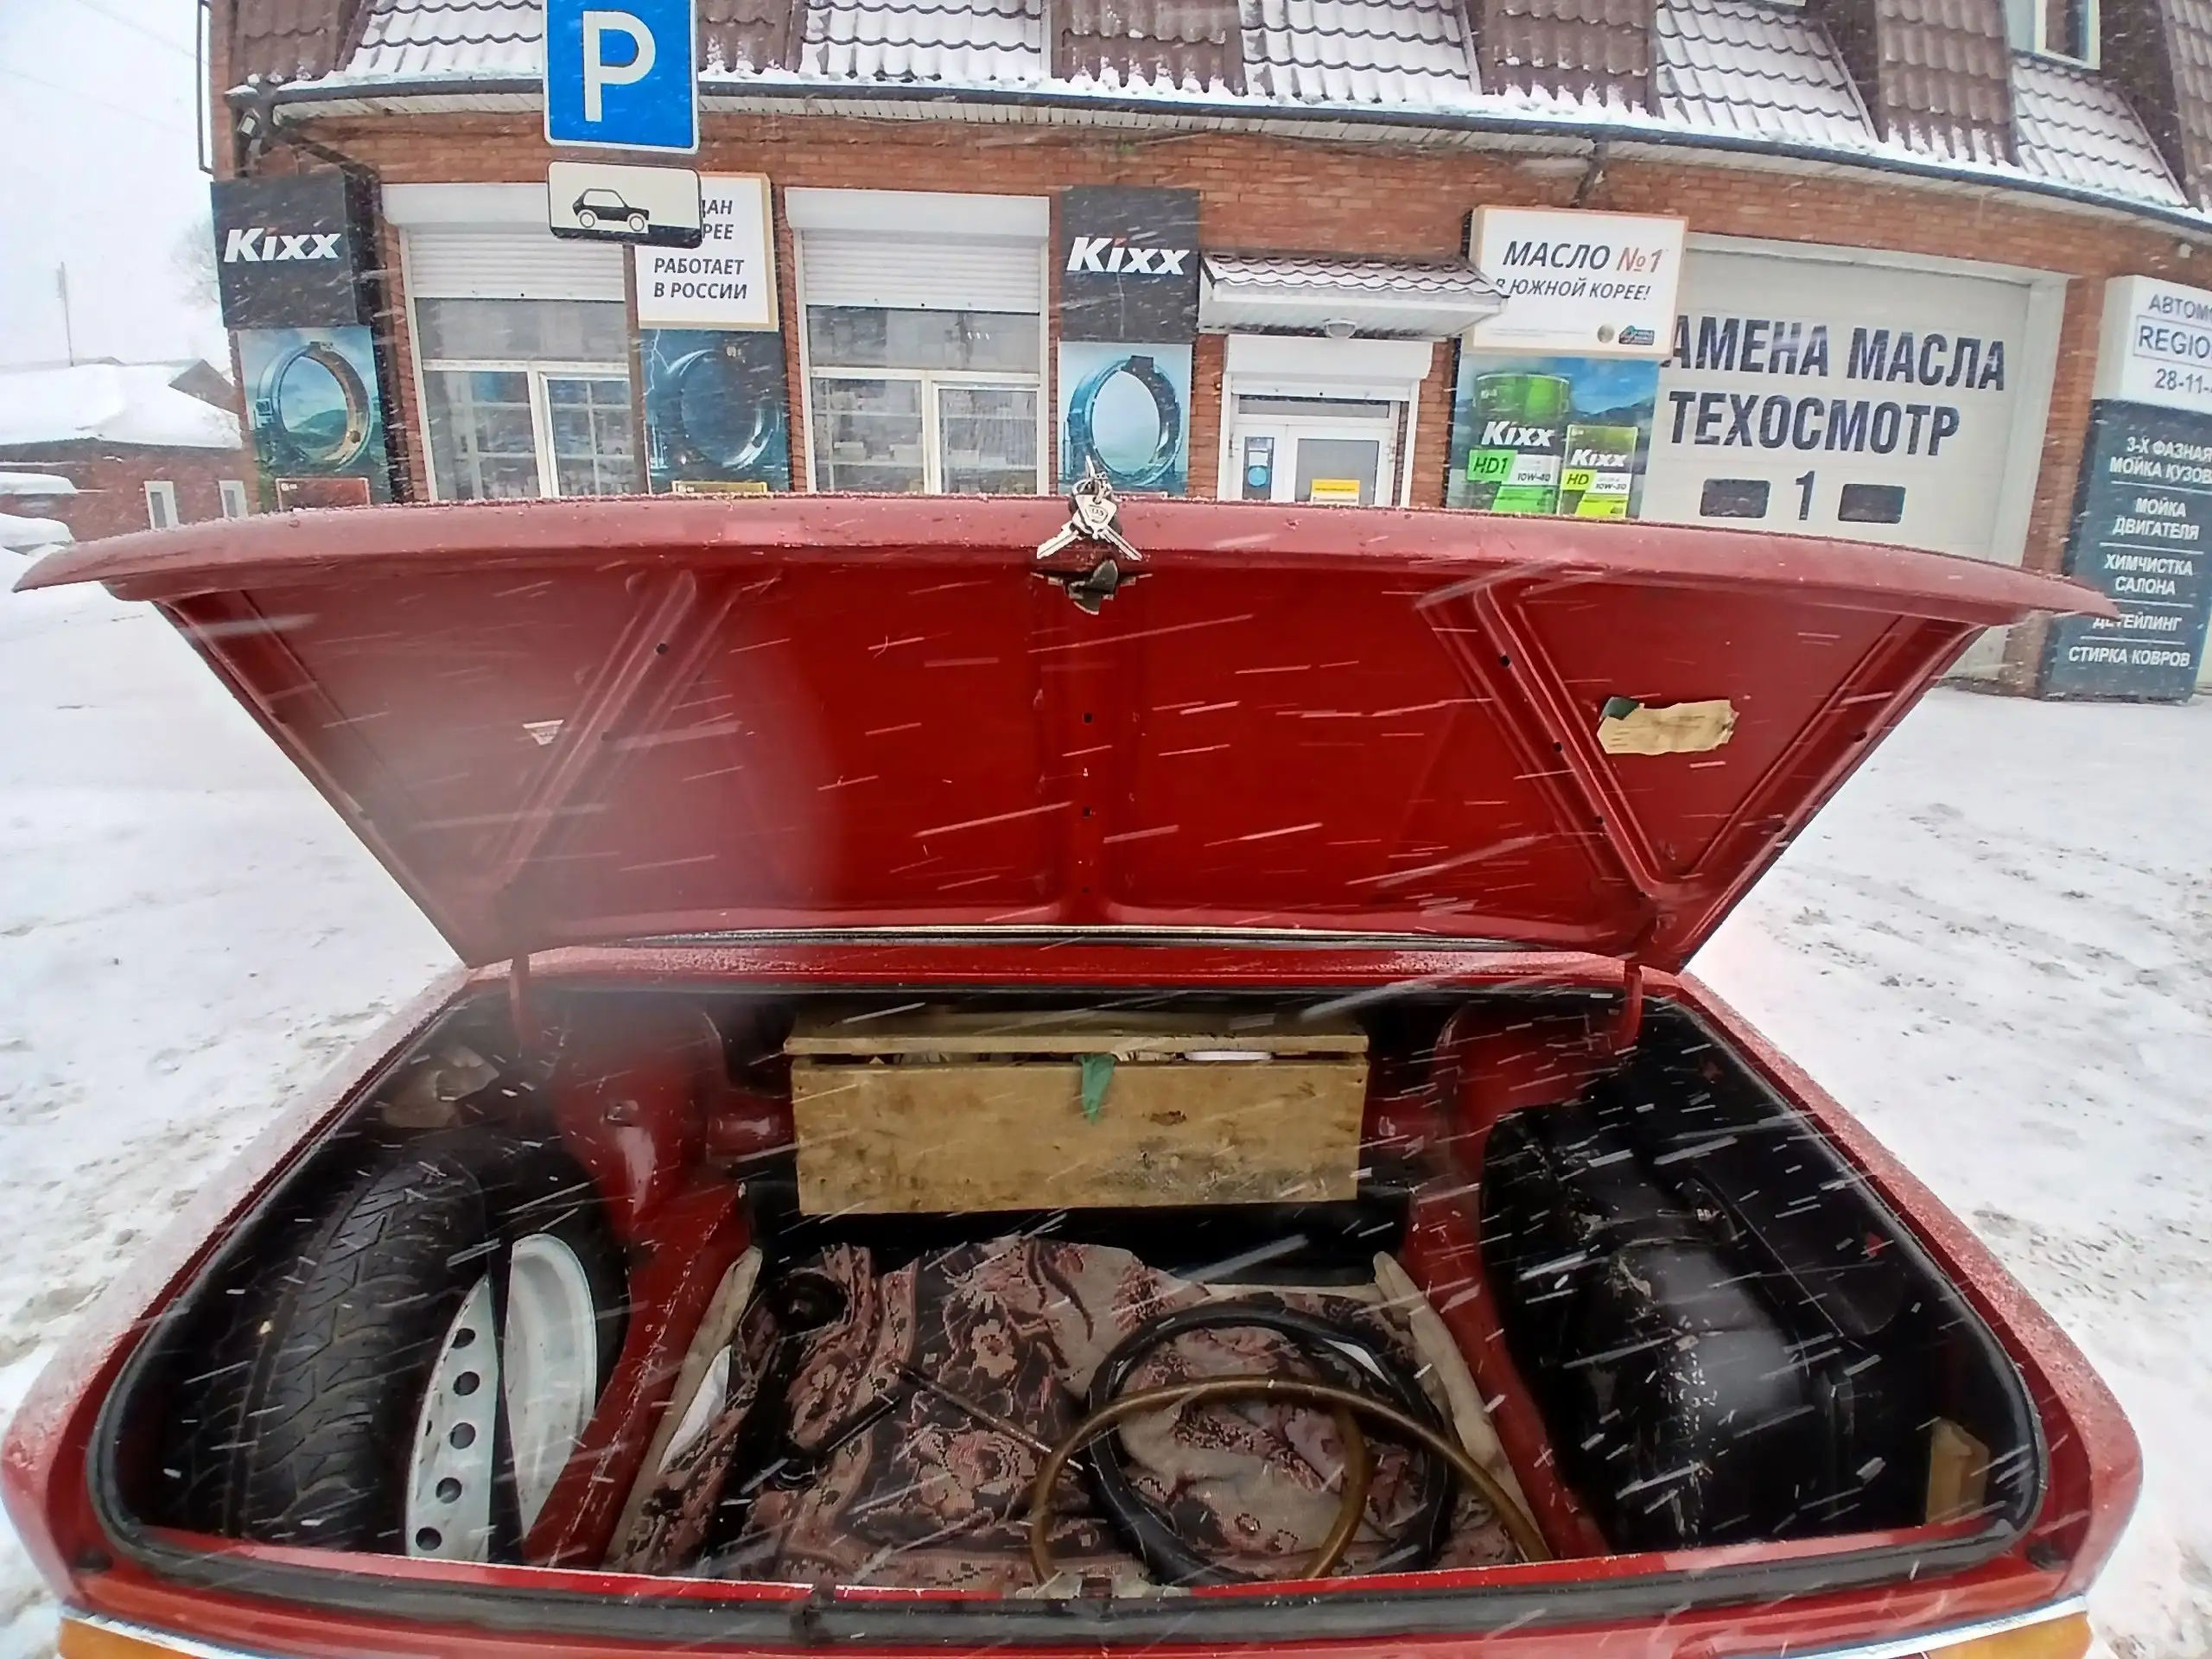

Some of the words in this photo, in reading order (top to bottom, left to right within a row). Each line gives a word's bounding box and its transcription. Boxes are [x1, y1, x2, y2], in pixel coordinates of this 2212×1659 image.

[582, 10, 657, 123] P
[702, 223, 734, 240] РЕЕ
[224, 227, 341, 263] Kixx
[1065, 235, 1190, 276] Kixx
[1502, 240, 1611, 270] МАСЛО
[1616, 247, 1664, 273] №1
[653, 257, 745, 276] РАБОТАЕТ
[653, 282, 665, 298] В
[671, 283, 748, 300] РОССИИ
[1509, 276, 1587, 297] ЮЖНОЙ
[1589, 282, 1651, 301] КОРЕЕ!
[2149, 294, 2212, 322] АВТОМ
[1662, 315, 1829, 378] АМЕНА
[1847, 327, 2005, 391] МАСЛА
[2139, 325, 2212, 360] REGIO
[2155, 368, 2212, 395] 28-11-
[1481, 421, 1555, 447] Kixx
[1669, 391, 1961, 456] ТЕХОСМОТР
[1570, 448, 1629, 467] Kixx
[2152, 440, 2212, 463] ФАЗНАЯ
[1472, 457, 1509, 474] HD1
[2109, 455, 2162, 478] МОЙКА
[1566, 474, 1590, 485] HD
[1796, 470, 1815, 520] 1
[2135, 497, 2187, 518] МОЙКА
[2112, 518, 2200, 541] ДВИГАТЕЛЯ
[2104, 554, 2193, 576] ХИМЧИСТКА
[2114, 575, 2176, 595] САЛОНА
[2069, 645, 2127, 664] СТИРКА
[2131, 650, 2191, 667] КОВРОВ
